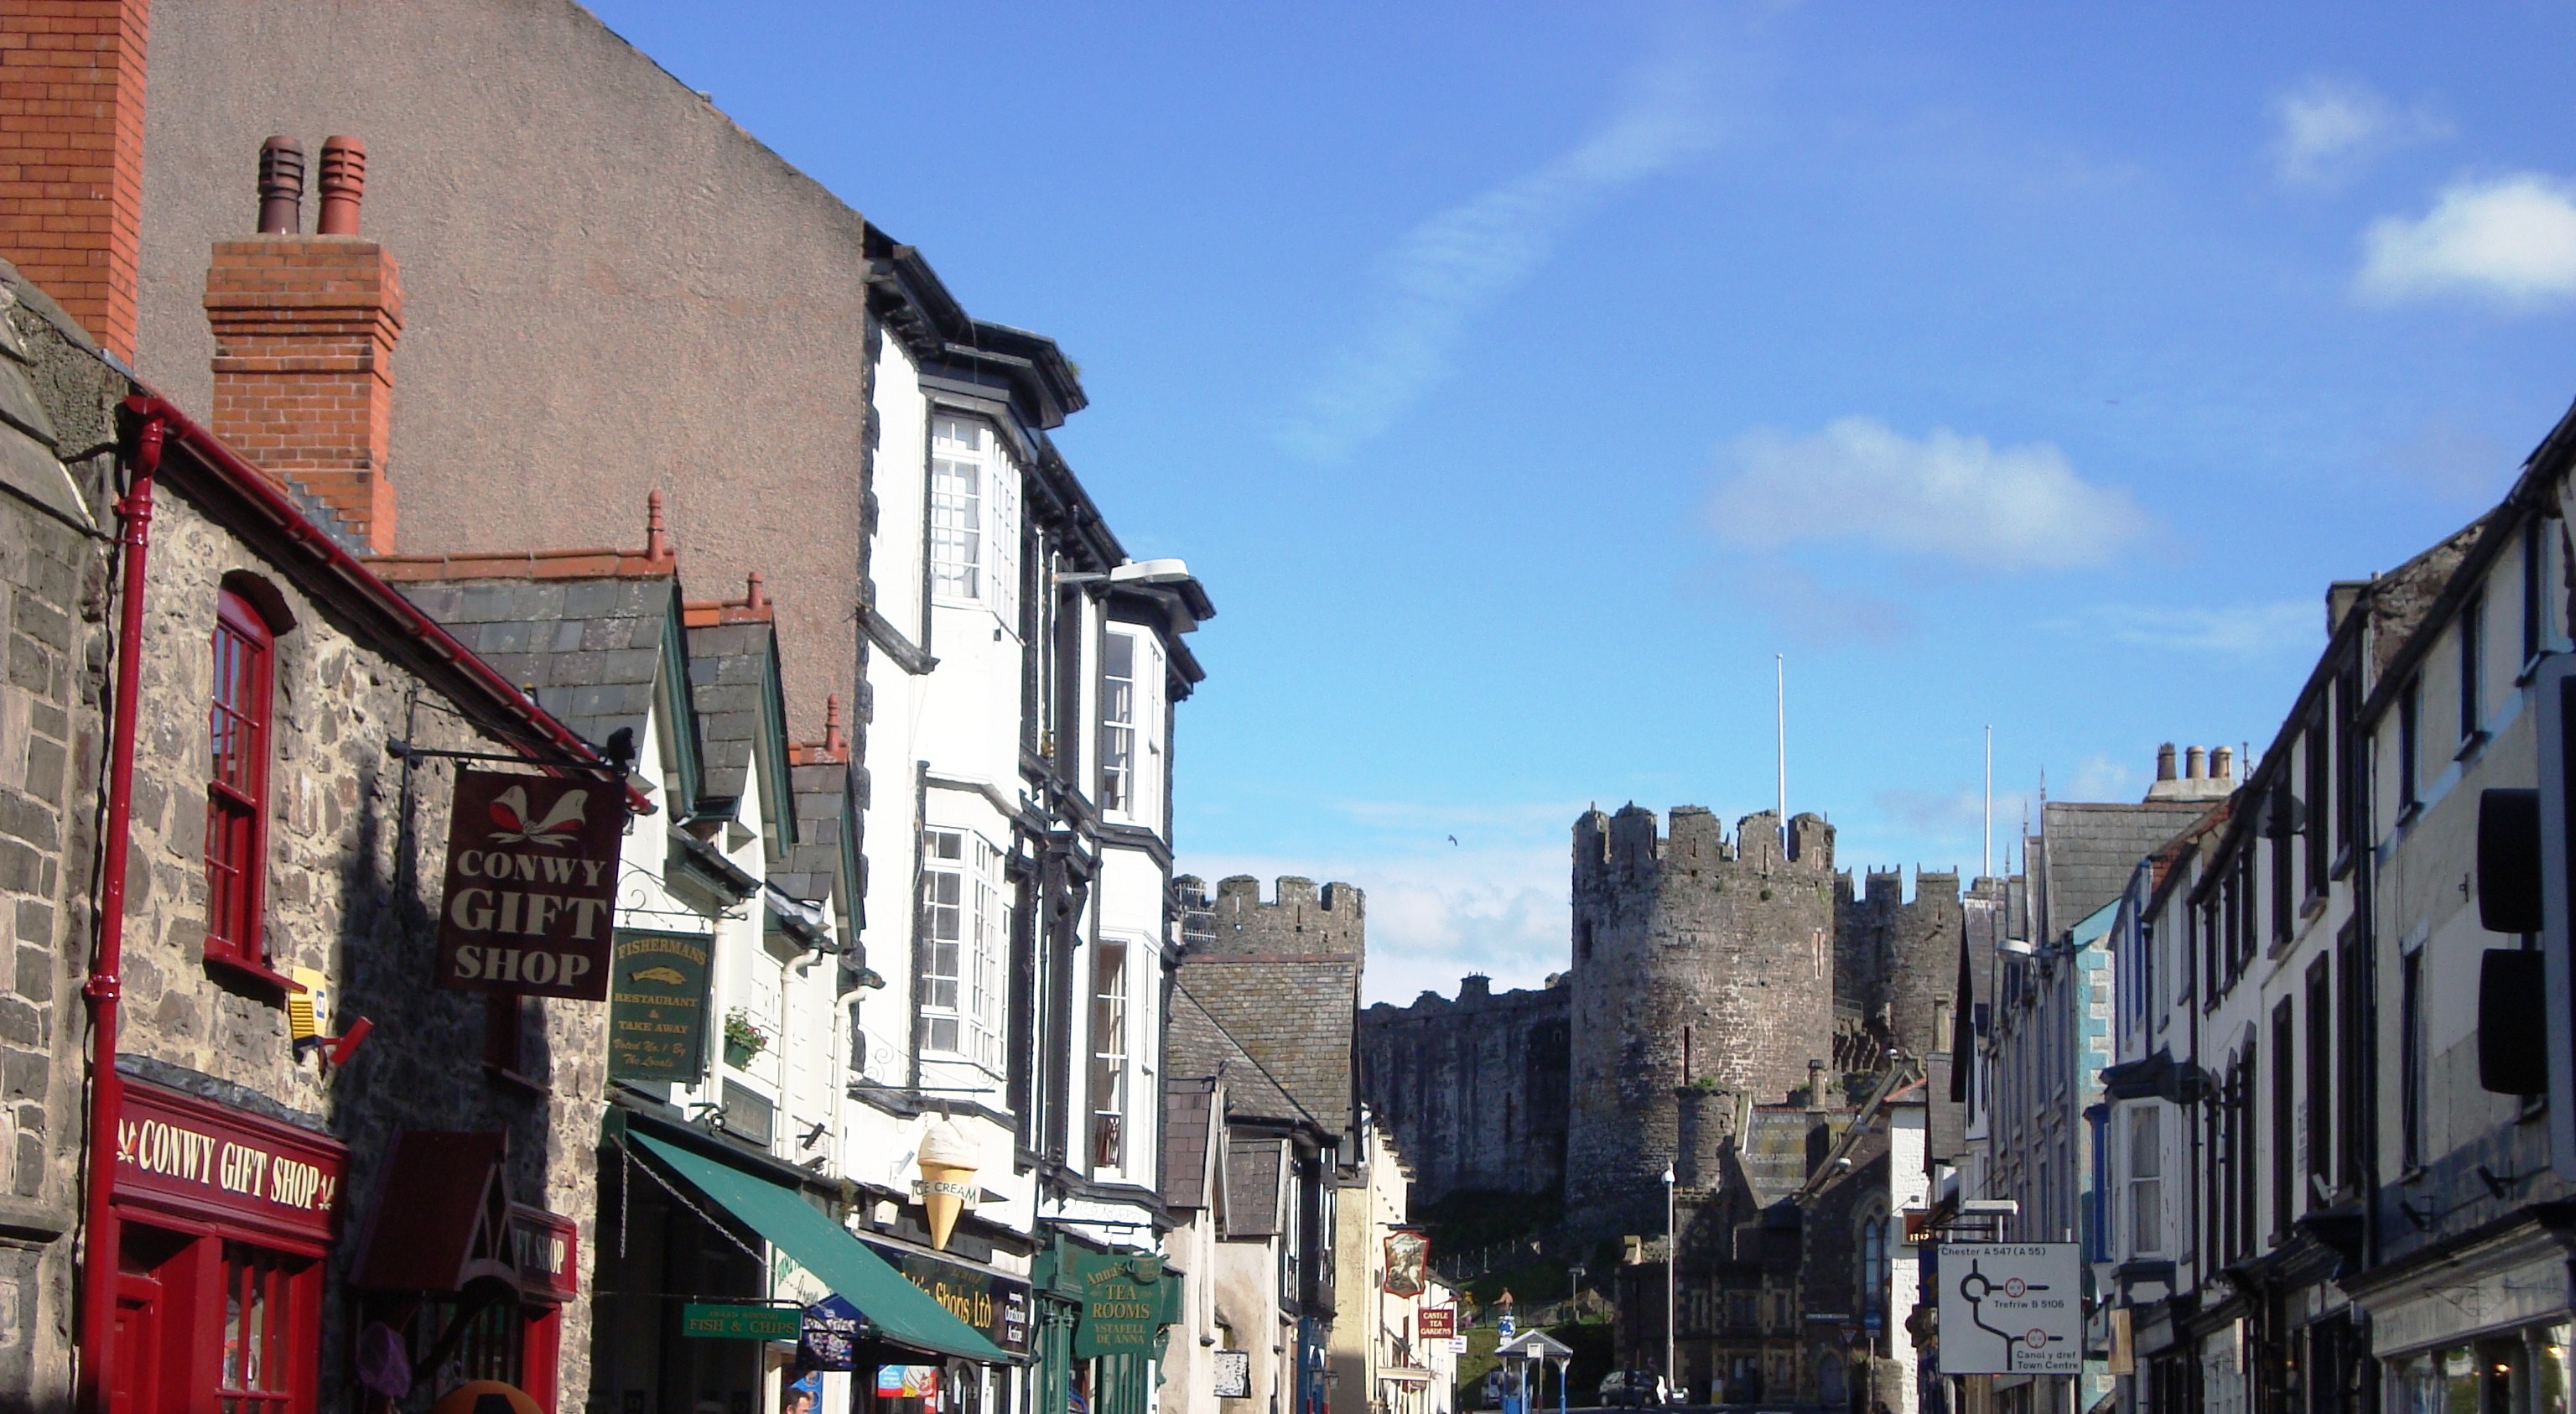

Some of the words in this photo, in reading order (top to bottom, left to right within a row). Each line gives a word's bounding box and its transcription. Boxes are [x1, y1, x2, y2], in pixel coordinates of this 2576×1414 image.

[457, 850, 606, 886] CONWY
[451, 888, 607, 940] GIFT
[617, 938, 707, 966] FISHERMANS
[454, 945, 591, 986] SHOP
[615, 993, 698, 1006] RESTAURANT
[649, 1009, 660, 1019] &
[618, 1021, 652, 1032] TAKE
[655, 1022, 688, 1034] AWAY
[613, 1038, 641, 1051] Voted
[673, 1042, 686, 1056] By
[623, 1053, 640, 1065] The
[138, 1119, 216, 1184] CONWY
[220, 1141, 267, 1198] GIFT
[270, 1156, 319, 1210] SHOP
[911, 1181, 930, 1198] ICE
[934, 1182, 977, 1205] CREAM
[536, 1234, 564, 1275] SHOP
[1941, 1247, 1980, 1256] Chester
[1993, 1247, 2012, 1256] 547
[1087, 1261, 1125, 1286] Anna's
[1106, 1285, 1137, 1301] TEA
[974, 1291, 992, 1328] Ltd
[1093, 1302, 1151, 1319] ROOMS
[1995, 1300, 2028, 1308] Trefriw
[2032, 1300, 2038, 1308] B
[2041, 1300, 2064, 1308] 5106
[688, 1318, 724, 1332] FISH
[730, 1321, 741, 1332] &
[749, 1321, 796, 1334] CHIPS
[1094, 1323, 1146, 1334] YSTAFELL
[1114, 1334, 1145, 1344] ANNA
[2017, 1350, 2045, 1359] Canol
[2018, 1361, 2043, 1370] Town
[2045, 1361, 2079, 1370] Centre
